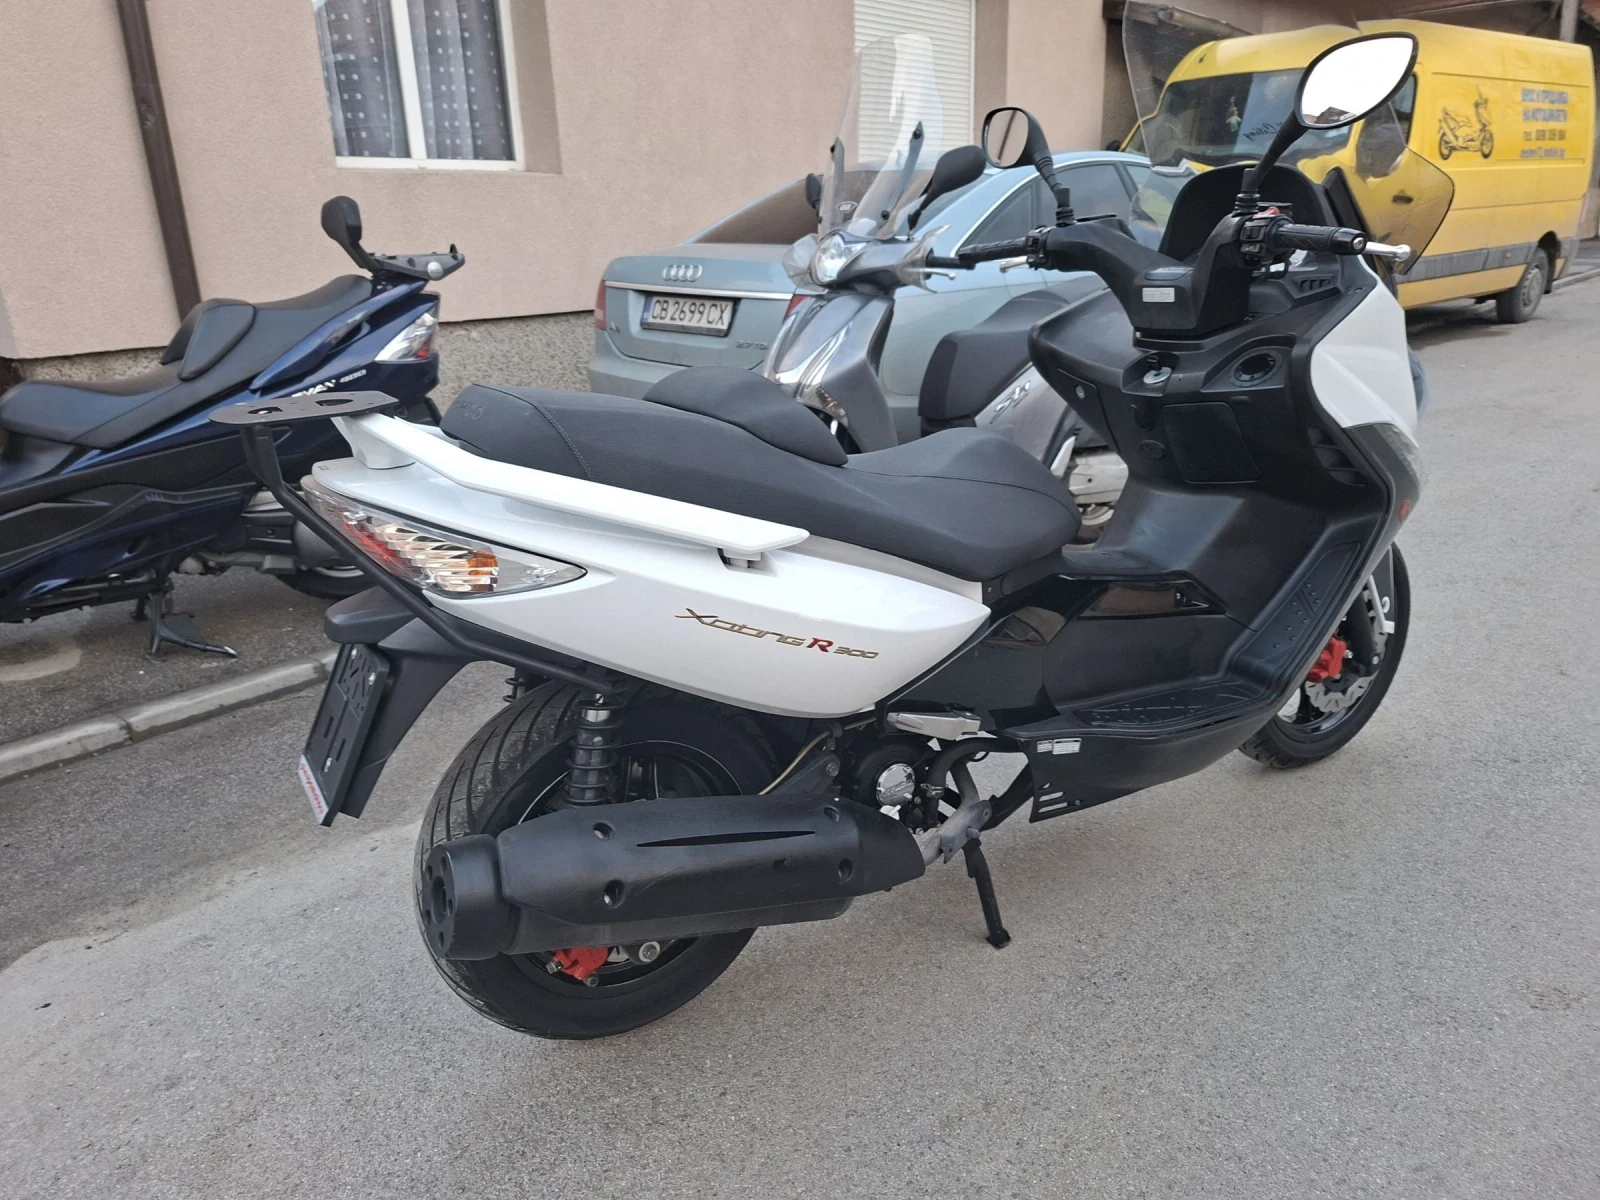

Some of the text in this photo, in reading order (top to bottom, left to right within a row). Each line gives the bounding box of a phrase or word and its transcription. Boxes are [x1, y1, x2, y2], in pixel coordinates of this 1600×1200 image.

[670, 301, 705, 324] 2699
[806, 637, 834, 653] R
[833, 646, 880, 659] 300
